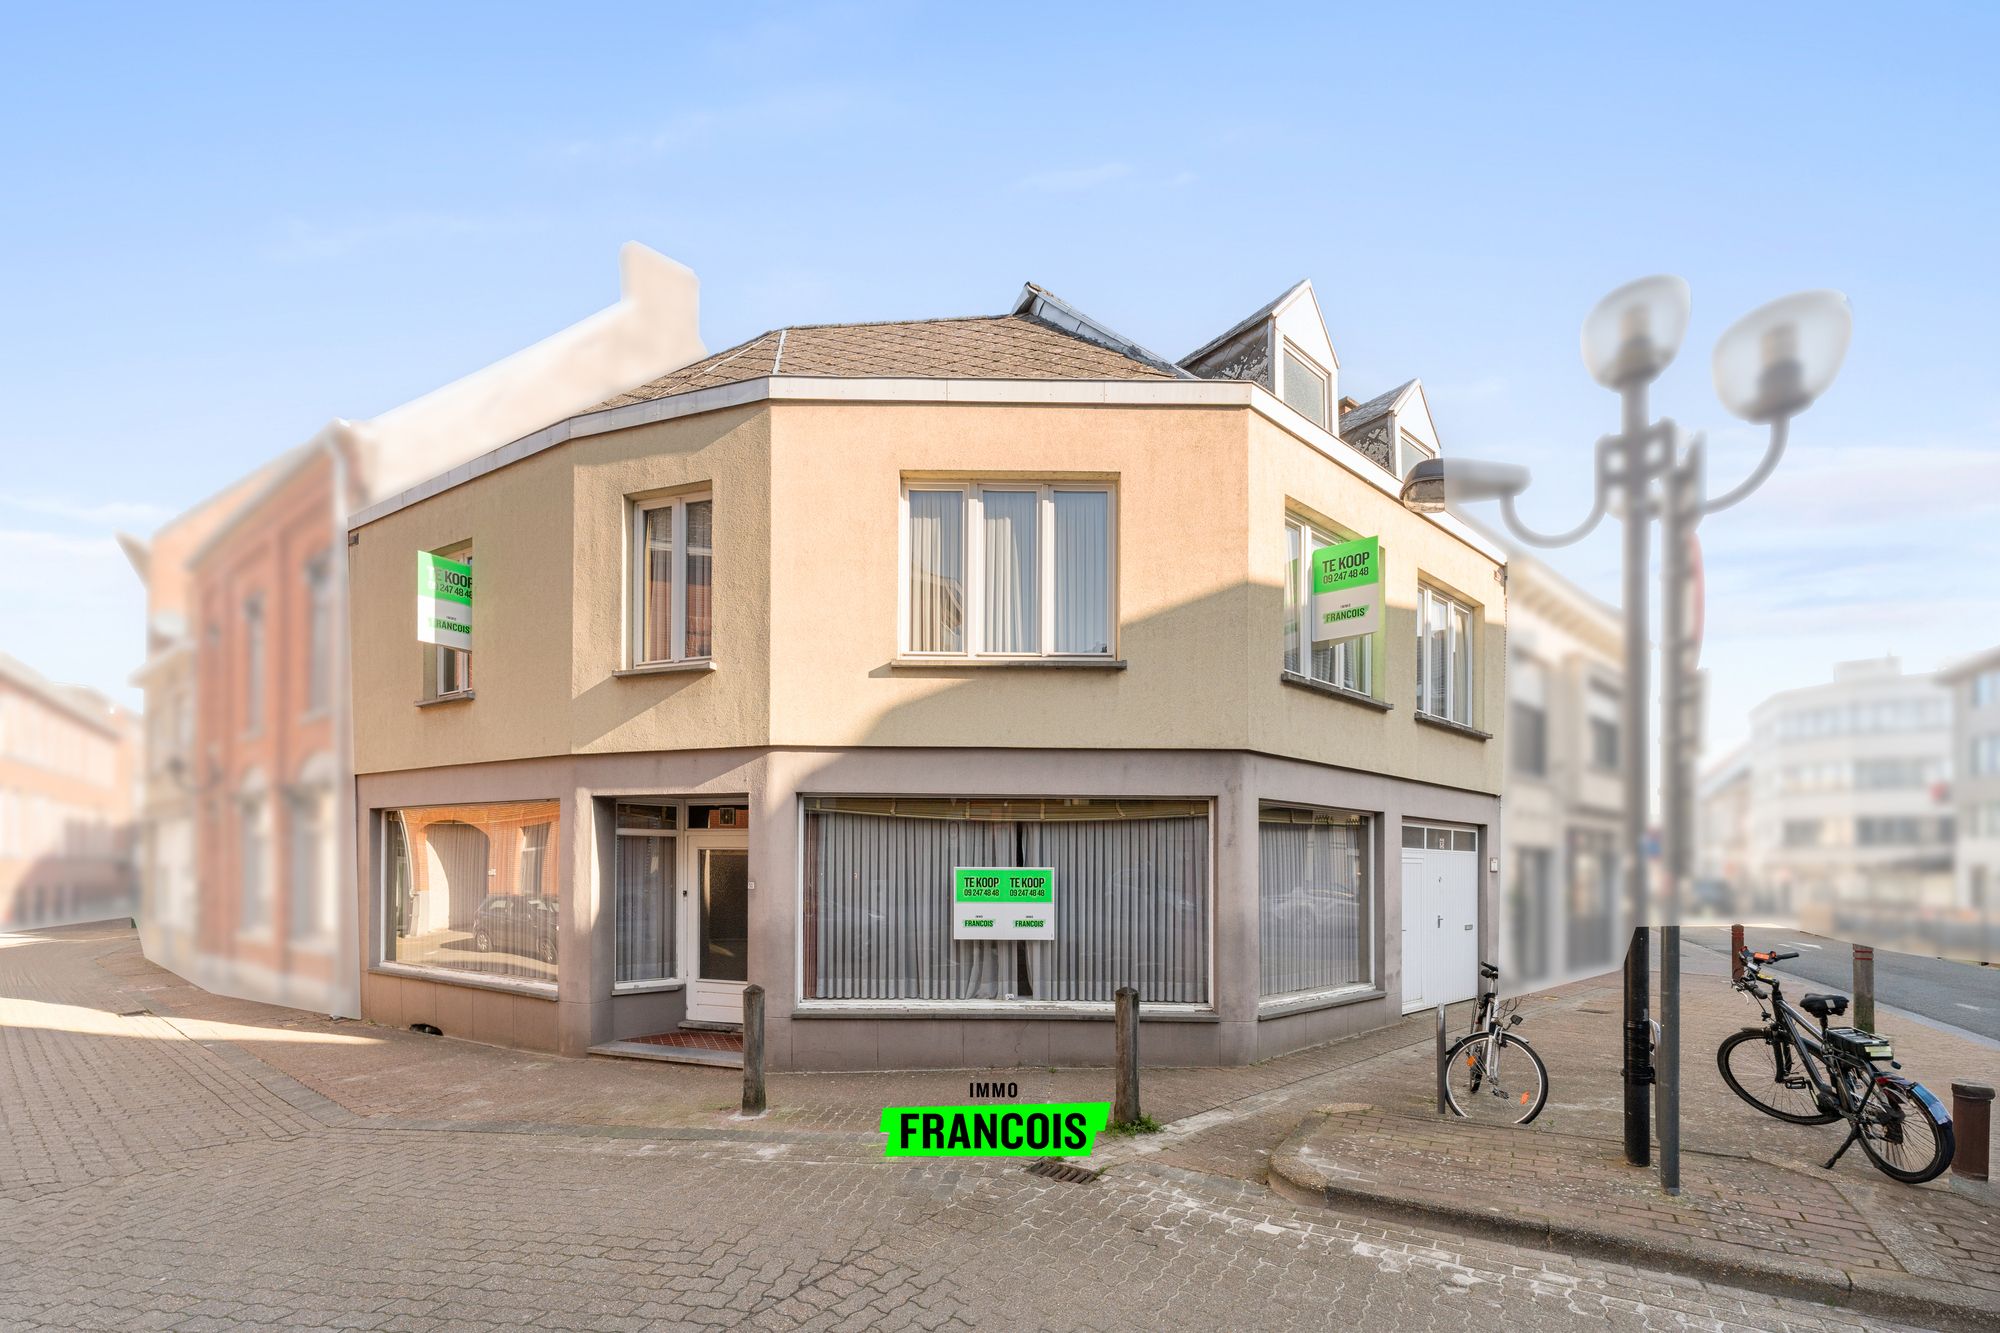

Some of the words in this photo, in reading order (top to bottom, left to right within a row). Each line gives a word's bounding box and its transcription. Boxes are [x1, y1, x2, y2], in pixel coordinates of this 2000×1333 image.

[1322, 559, 1336, 573] TE
[1338, 552, 1370, 570] KOOP
[1323, 574, 1333, 584] 09
[1333, 571, 1347, 582] 247
[1348, 568, 1358, 579] 48
[1359, 566, 1369, 576] 48
[1326, 607, 1365, 622] FRANCOIS
[964, 877, 974, 888] TE
[976, 877, 1000, 888] KOOP
[1010, 877, 1020, 888] TE
[1022, 877, 1045, 888] KOOP
[973, 889, 983, 897] 247
[1018, 889, 1028, 897] 247
[964, 920, 994, 928] FRANCOIS
[1015, 920, 1044, 928] FRANCOIS
